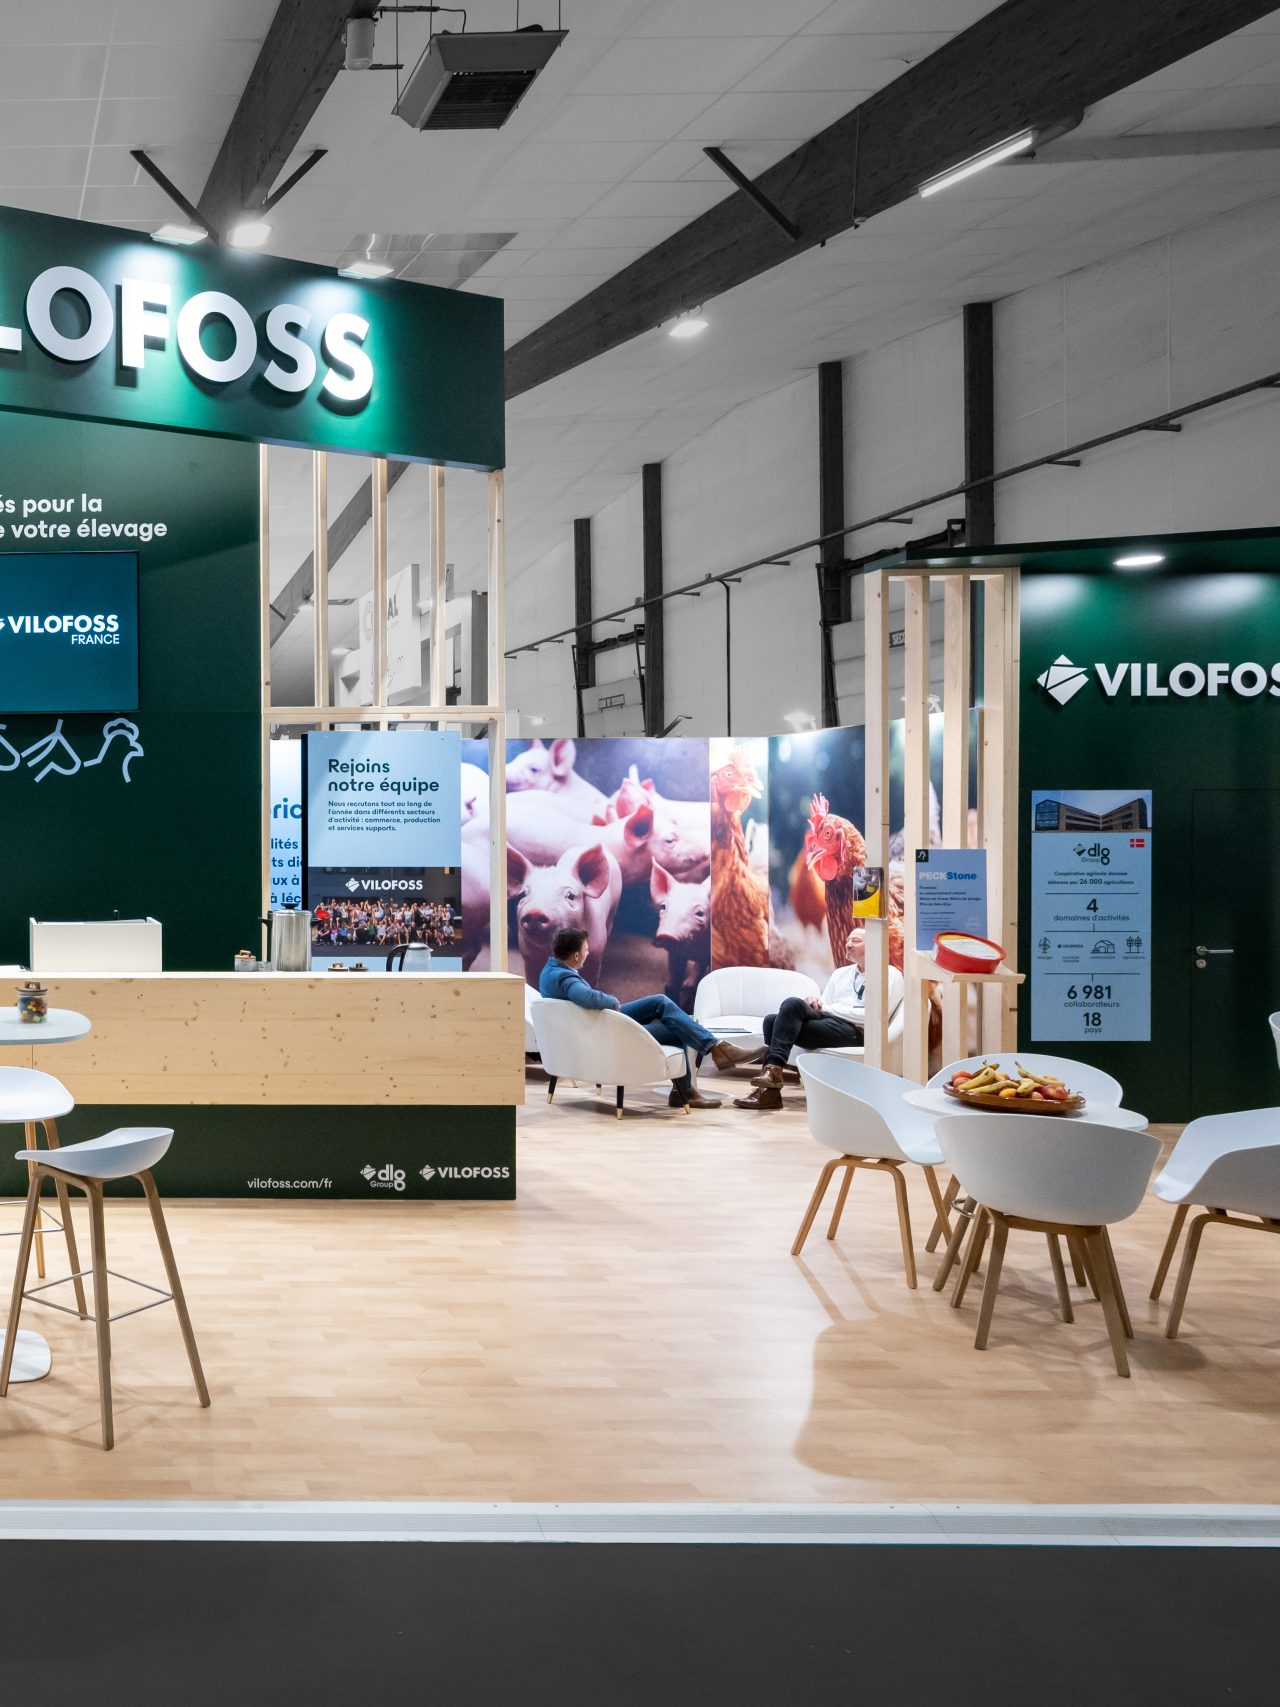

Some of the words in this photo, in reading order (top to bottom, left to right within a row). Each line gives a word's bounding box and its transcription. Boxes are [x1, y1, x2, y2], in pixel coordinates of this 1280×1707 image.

[22, 498, 75, 517] pour
[81, 493, 103, 513] la
[11, 521, 71, 539] votre
[76, 519, 168, 542] élevage
[7, 614, 120, 634] VILOFOSS
[71, 634, 120, 645] FRANCE
[328, 758, 390, 777] Rejoins
[328, 779, 374, 792] notre
[380, 777, 439, 795] équipe
[1088, 843, 1110, 866] dlg
[291, 874, 300, 886] à
[361, 879, 424, 891] VILOFOSS
[1086, 898, 1099, 912] 4
[1067, 985, 1078, 1000] 6
[1082, 985, 1112, 1000] 981
[1063, 1000, 1120, 1008] collaborateurs
[1083, 1012, 1102, 1027] 18
[377, 1164, 406, 1192] dlg
[437, 1166, 510, 1179] VILOFOSS
[247, 1177, 333, 1190] vilofoss.com/fr
[370, 1180, 394, 1190] Group
